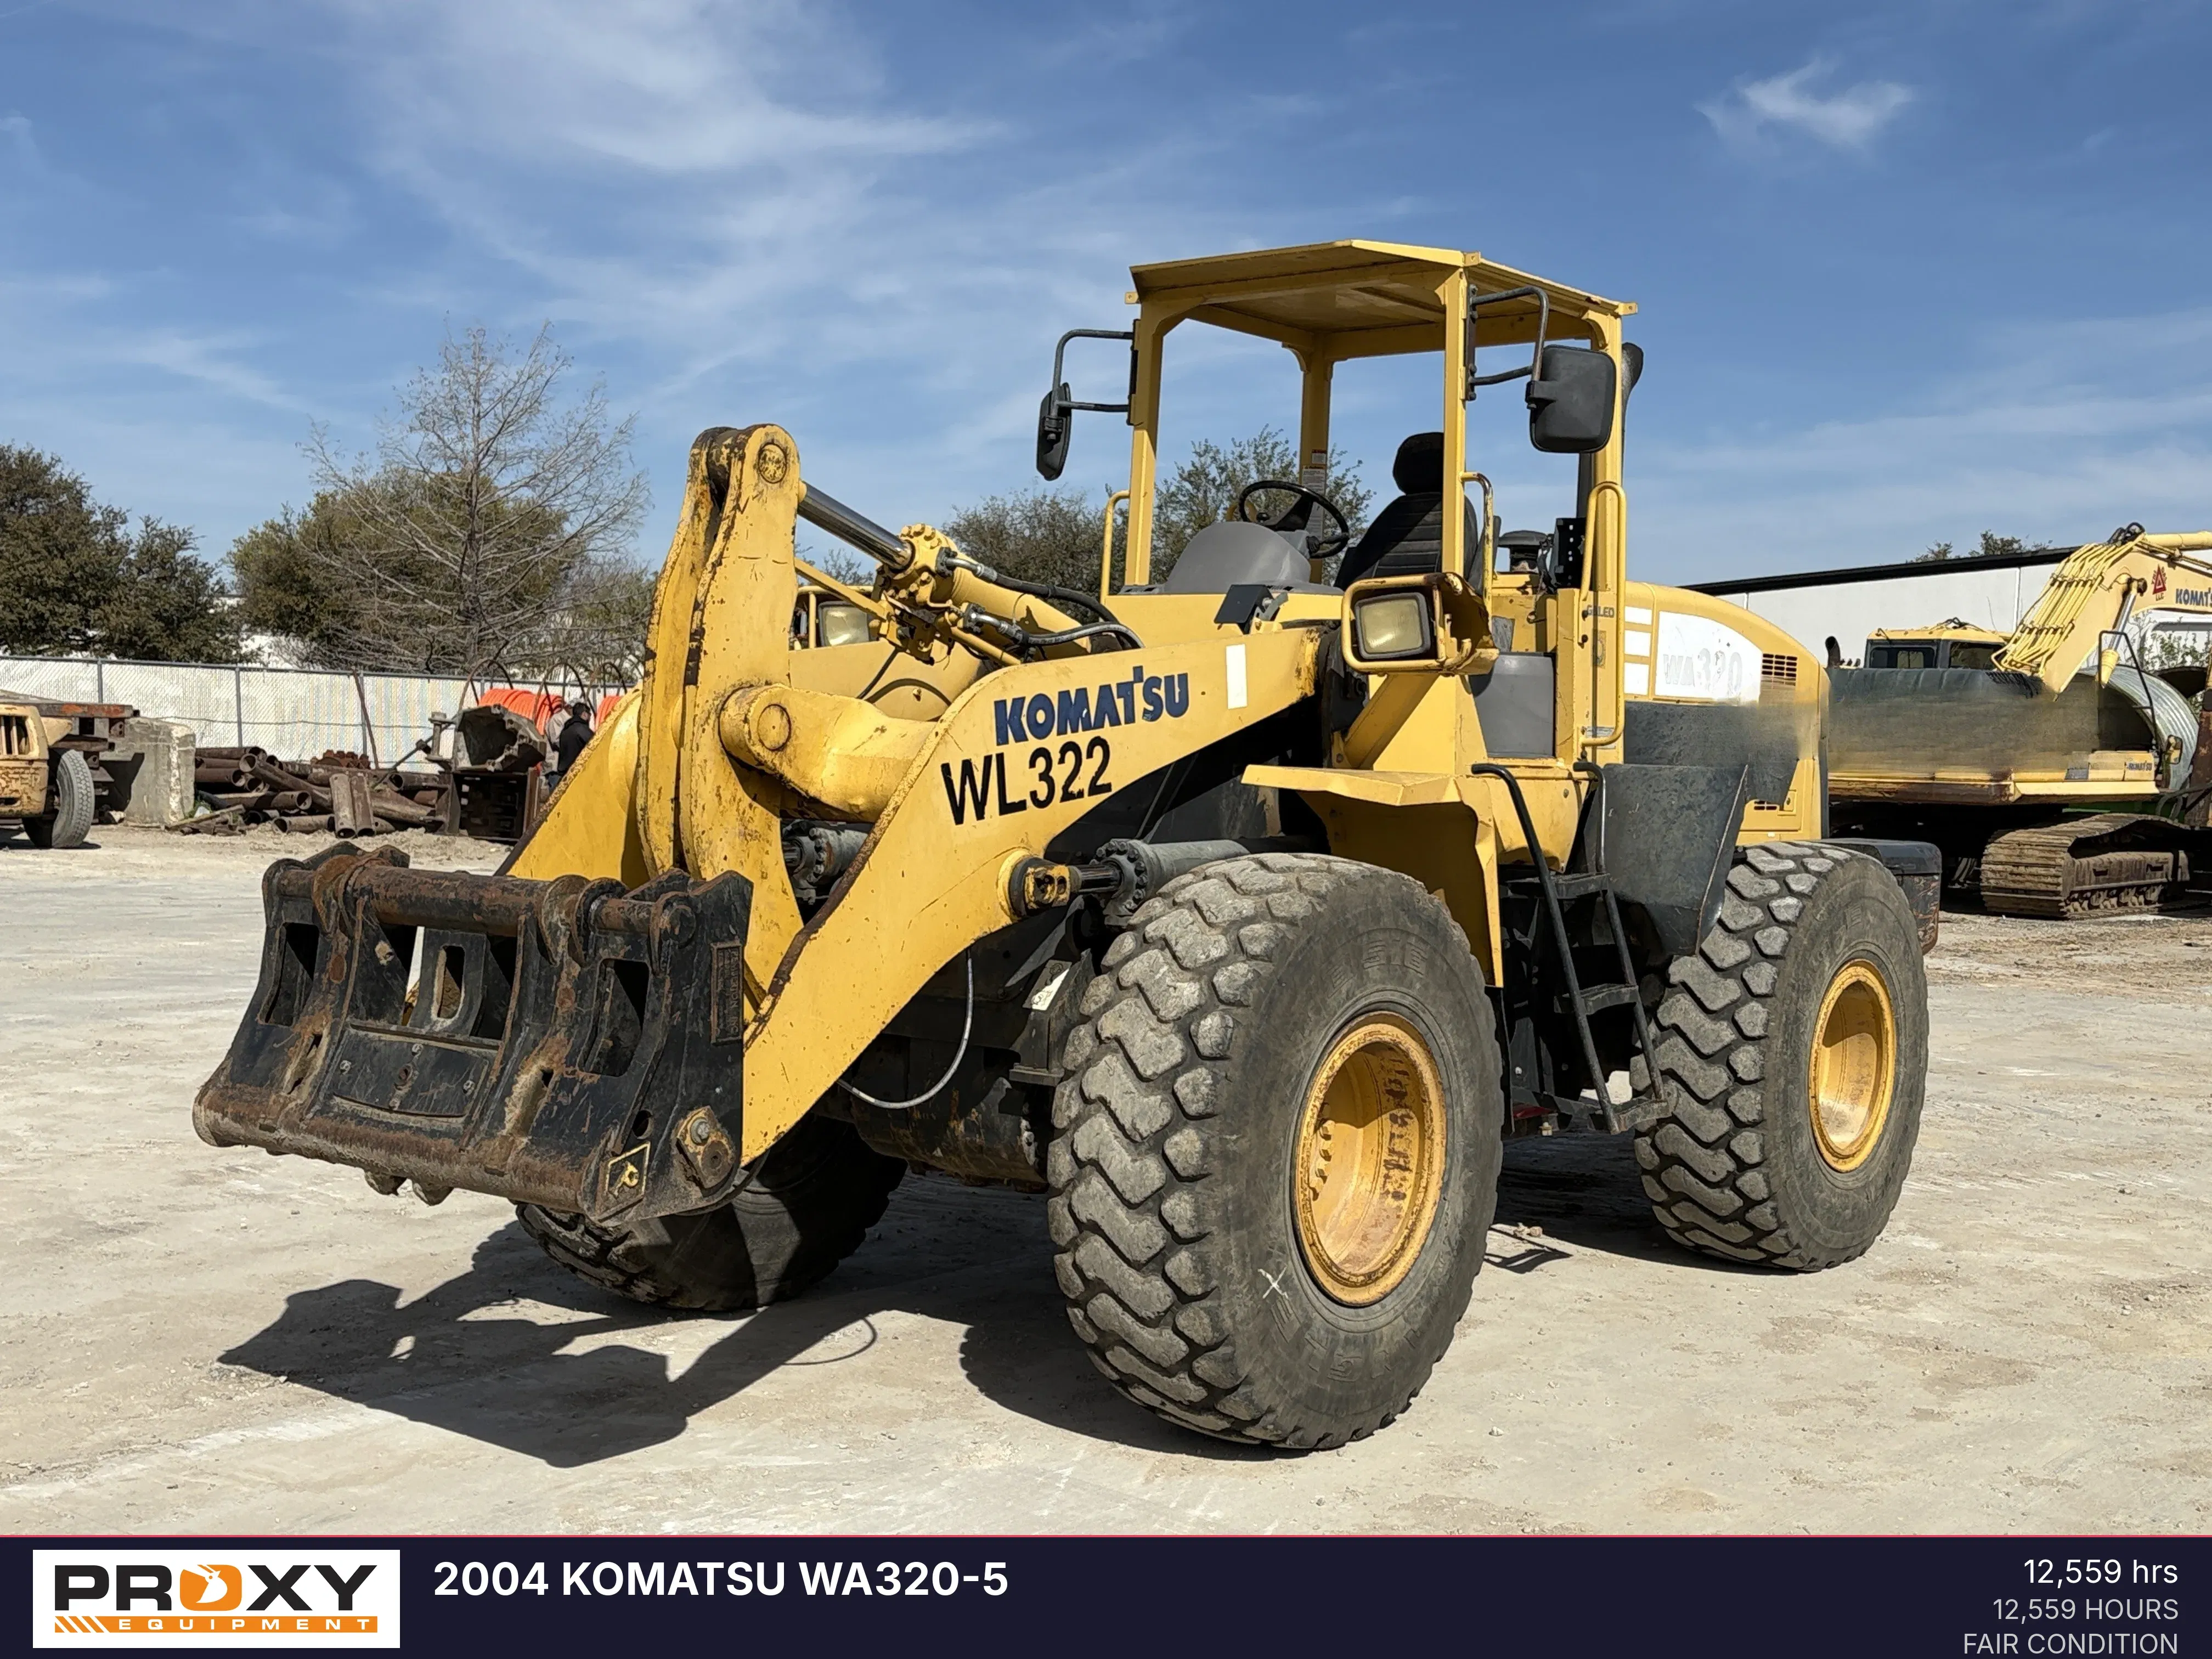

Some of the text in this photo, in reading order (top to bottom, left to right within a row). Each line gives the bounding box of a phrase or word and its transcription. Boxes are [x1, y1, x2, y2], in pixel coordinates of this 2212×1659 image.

[1587, 604, 1615, 618] GLEO
[994, 665, 1190, 747] KOMATSU
[940, 736, 1112, 826] WL322
